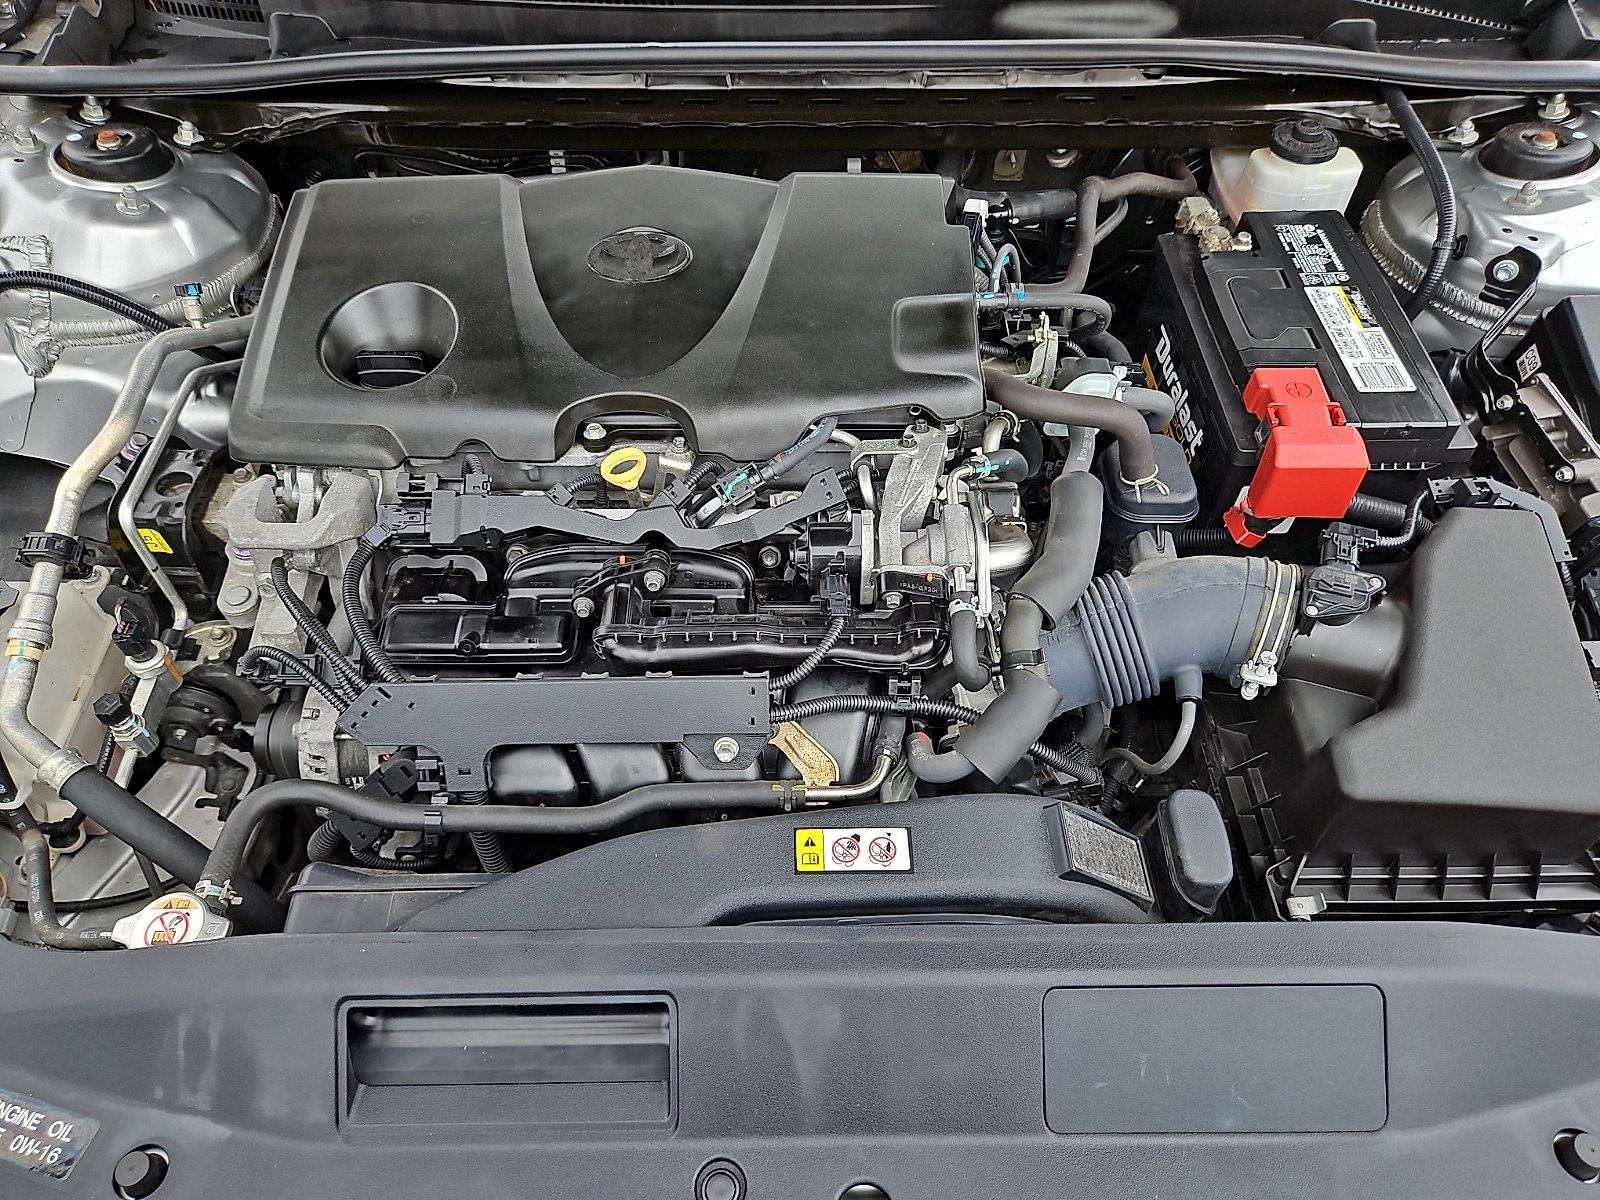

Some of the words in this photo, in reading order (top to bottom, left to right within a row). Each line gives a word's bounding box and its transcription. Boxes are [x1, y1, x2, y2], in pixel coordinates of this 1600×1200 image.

[1526, 350, 1538, 371] CG9
[1155, 323, 1204, 457] Duralast
[0, 1099, 46, 1131] NGINE
[47, 1120, 75, 1143] OIL
[9, 1134, 63, 1164] 0W-16
